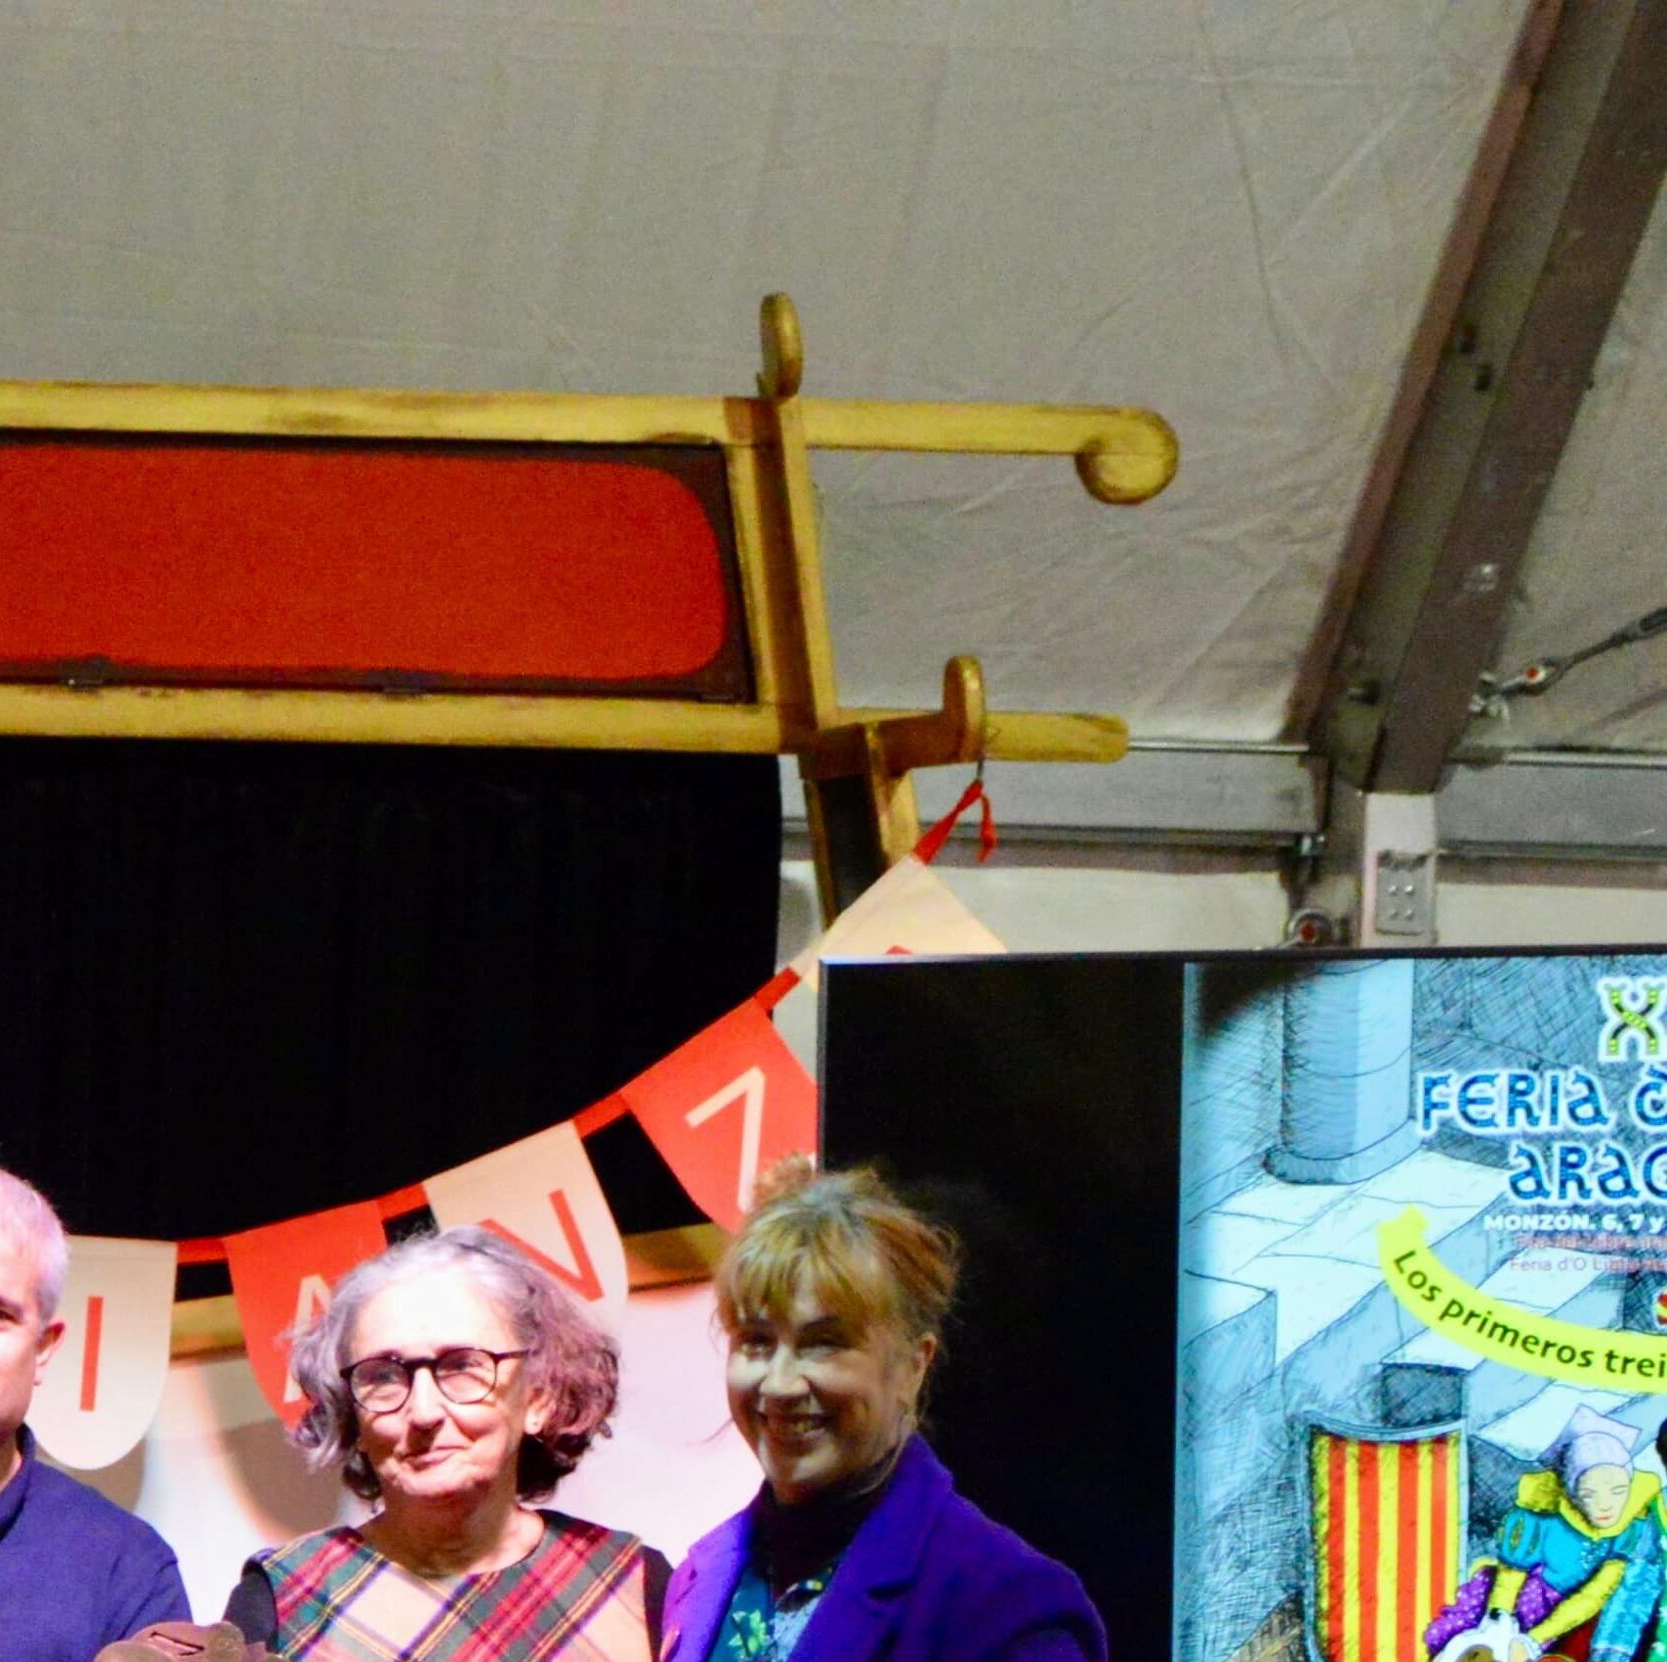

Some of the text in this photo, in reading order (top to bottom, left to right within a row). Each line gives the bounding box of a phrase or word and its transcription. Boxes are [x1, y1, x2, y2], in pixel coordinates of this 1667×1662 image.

[1421, 1071, 1609, 1132] FERIA
[1483, 1210, 1596, 1231] MONZÓN.
[1393, 1250, 1443, 1302] Los
[1438, 1298, 1594, 1368] primeros
